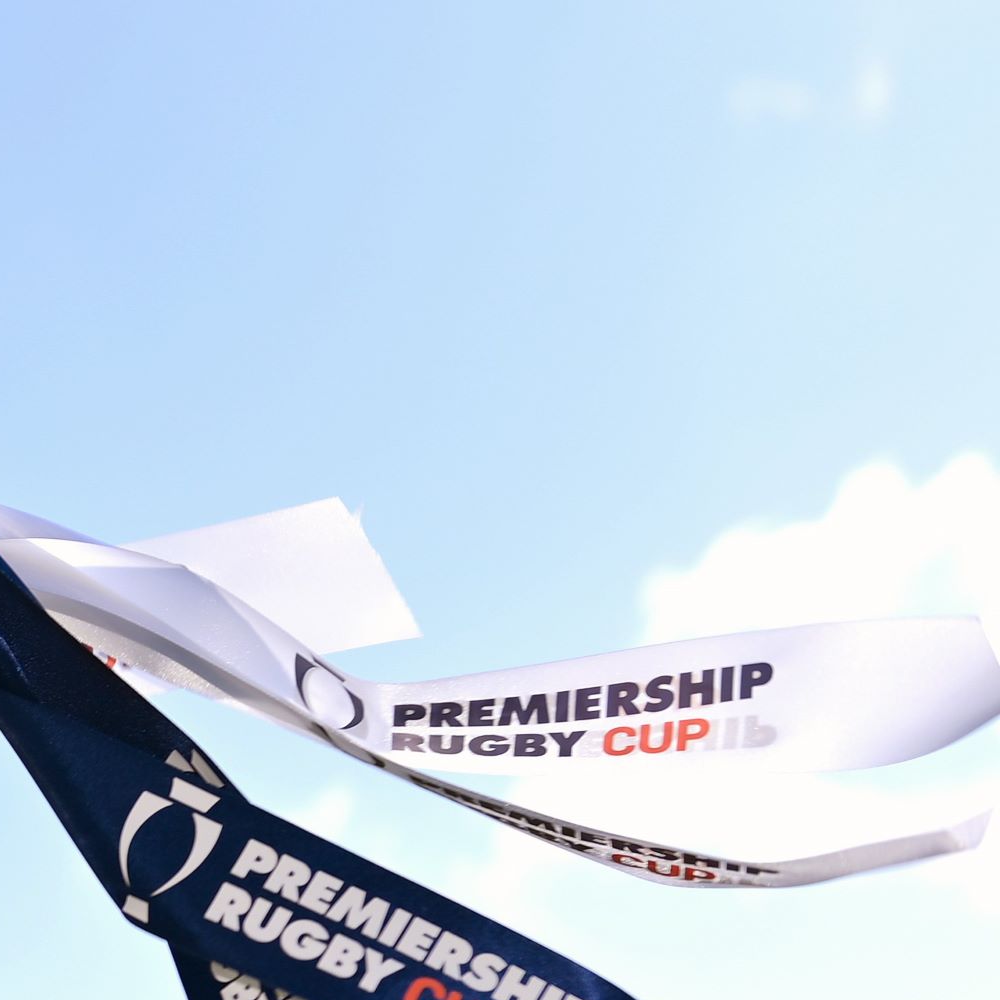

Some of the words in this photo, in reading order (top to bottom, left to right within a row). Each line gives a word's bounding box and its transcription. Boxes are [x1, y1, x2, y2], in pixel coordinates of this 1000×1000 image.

[392, 661, 774, 727] PREMIERSHIP
[391, 730, 585, 757] RUGBY
[602, 718, 709, 756] CUP
[611, 853, 716, 882] CUP
[204, 881, 405, 993] RUGBY
